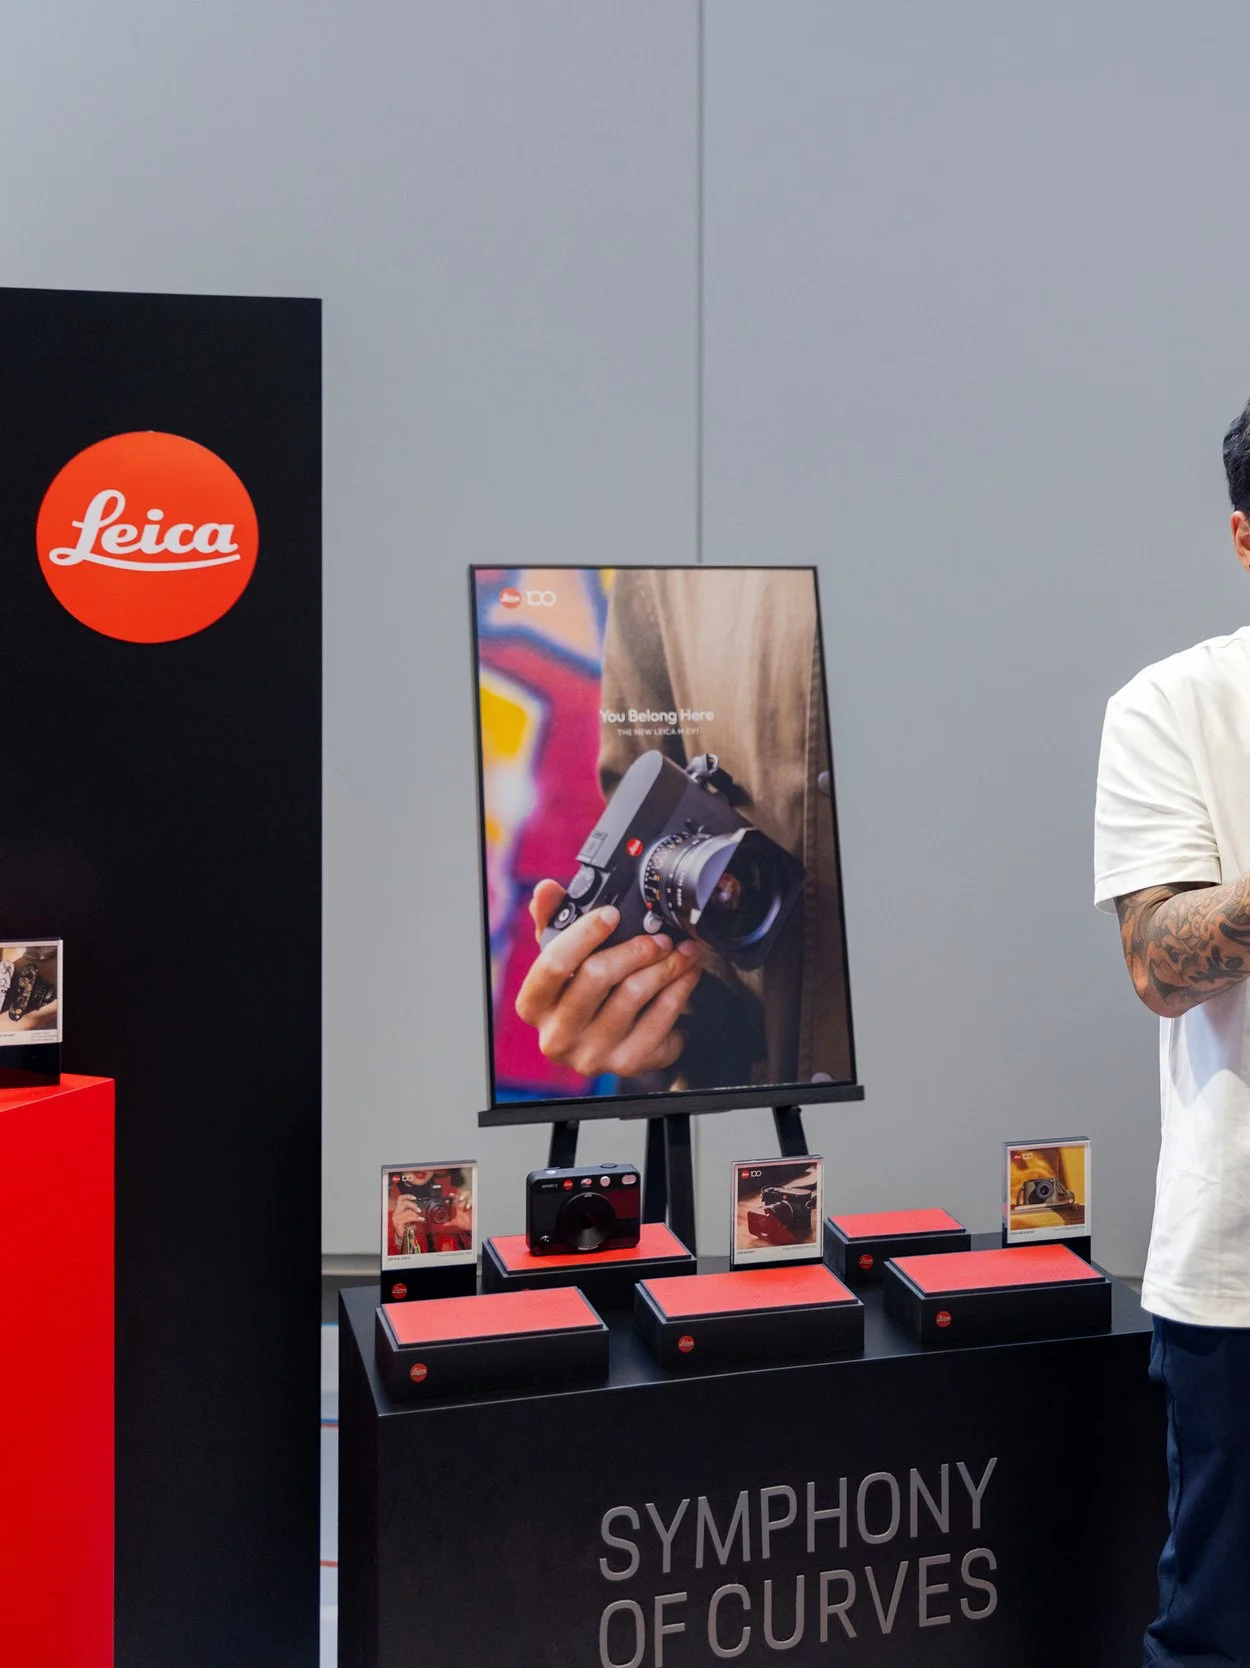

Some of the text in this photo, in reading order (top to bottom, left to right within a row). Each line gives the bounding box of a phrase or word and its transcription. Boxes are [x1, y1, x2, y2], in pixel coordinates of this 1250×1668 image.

[48, 489, 241, 572] Leica
[525, 590, 557, 606] 100
[599, 708, 715, 725] You Belong Here
[617, 728, 632, 737] THE
[634, 728, 653, 737] NEW
[599, 1457, 998, 1581] SYMPHONY
[599, 1547, 998, 1668] OF CURVES
